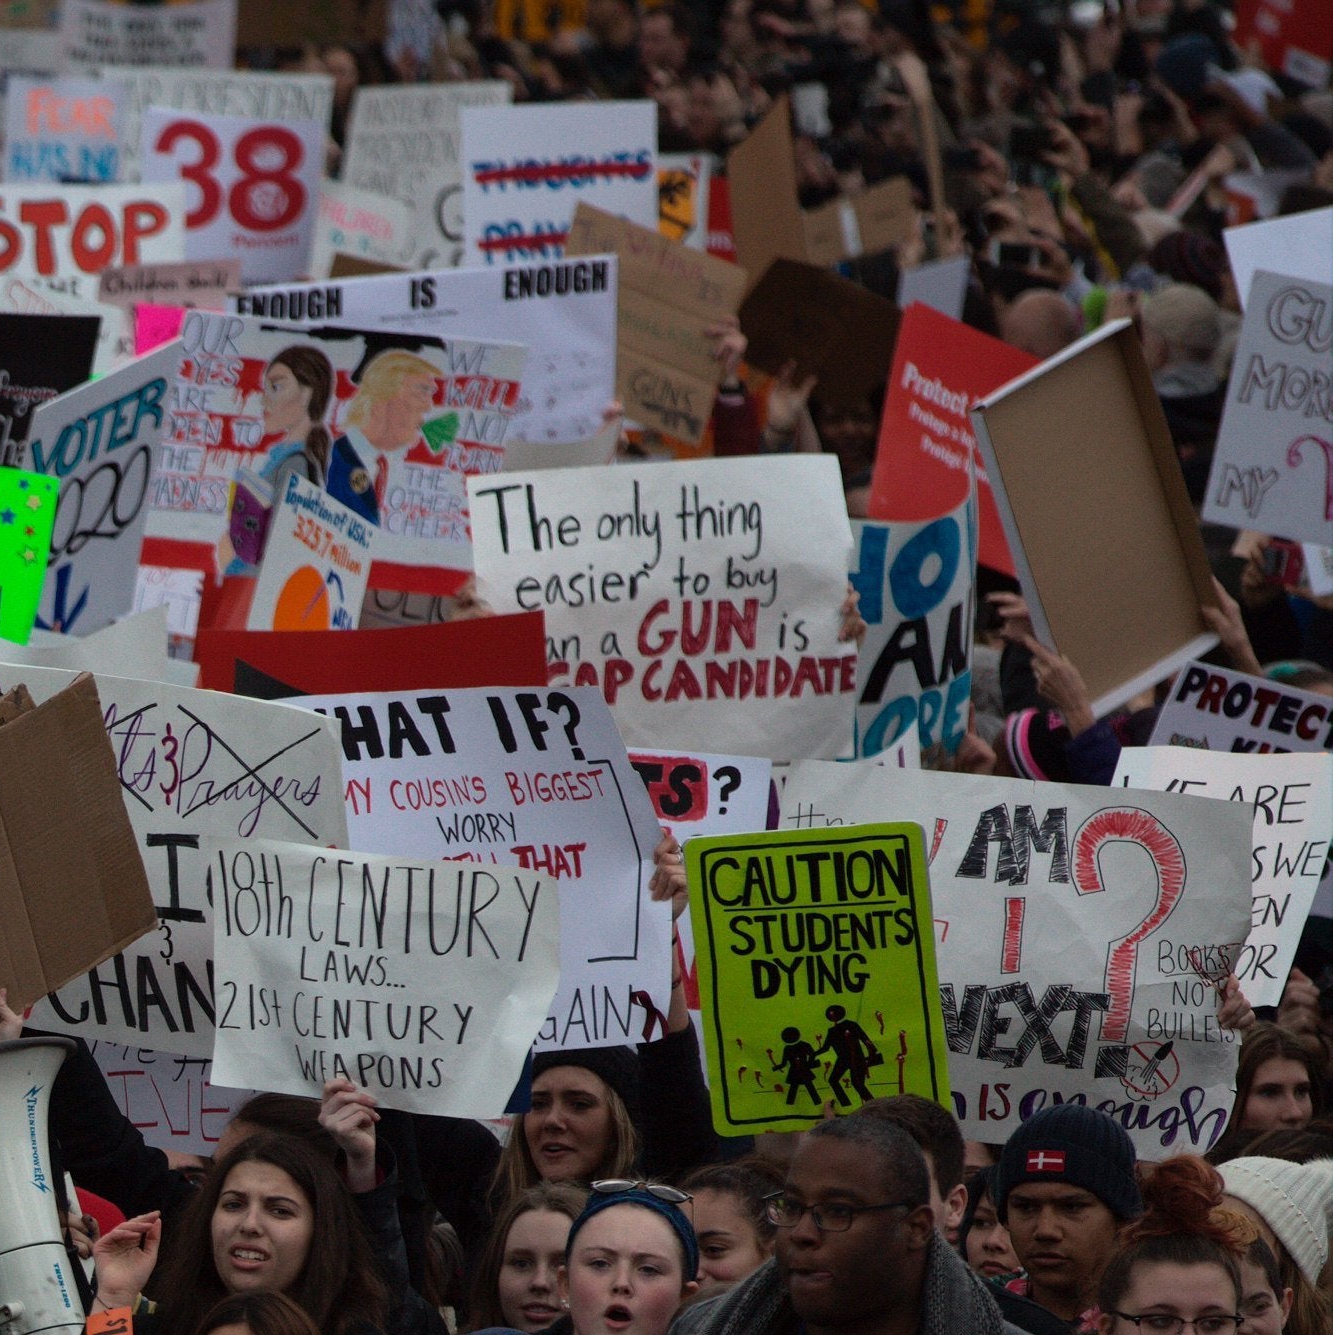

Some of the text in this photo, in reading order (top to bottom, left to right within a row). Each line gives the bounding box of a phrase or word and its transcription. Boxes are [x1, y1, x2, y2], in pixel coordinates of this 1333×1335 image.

[26, 87, 117, 137] FEAR
[155, 118, 306, 232] 38
[472, 151, 651, 191] THOUGHTS
[237, 261, 608, 320] ENOUGH IS ENOUGH
[184, 314, 244, 355] OUR
[901, 362, 968, 418] Protect
[32, 378, 167, 476] VOTER
[160, 446, 201, 471] THE
[405, 466, 451, 490] THE
[390, 487, 462, 513] OTHER
[1218, 463, 1279, 518] MY
[476, 481, 763, 568] The only thing
[515, 558, 779, 610] easier to buy
[601, 600, 810, 656] a GUN is
[642, 654, 857, 702] CANDIDATE
[487, 692, 585, 761] IF?
[390, 769, 606, 812] COUSIN'S BIGGEST
[436, 812, 517, 845] WORRY
[956, 804, 1068, 886] AM
[511, 842, 586, 880] THAT
[709, 848, 908, 908] CAUTION
[218, 850, 542, 962] 18th CENTURY
[729, 908, 916, 955] STUDENTS
[301, 949, 407, 990] LAWS...
[750, 951, 870, 999] DYING
[218, 981, 474, 1044] 21st CENTURY
[296, 1046, 445, 1089] WEAPONS
[978, 1083, 1011, 1122] IS
[54, 1263, 71, 1308] THUN-1200
